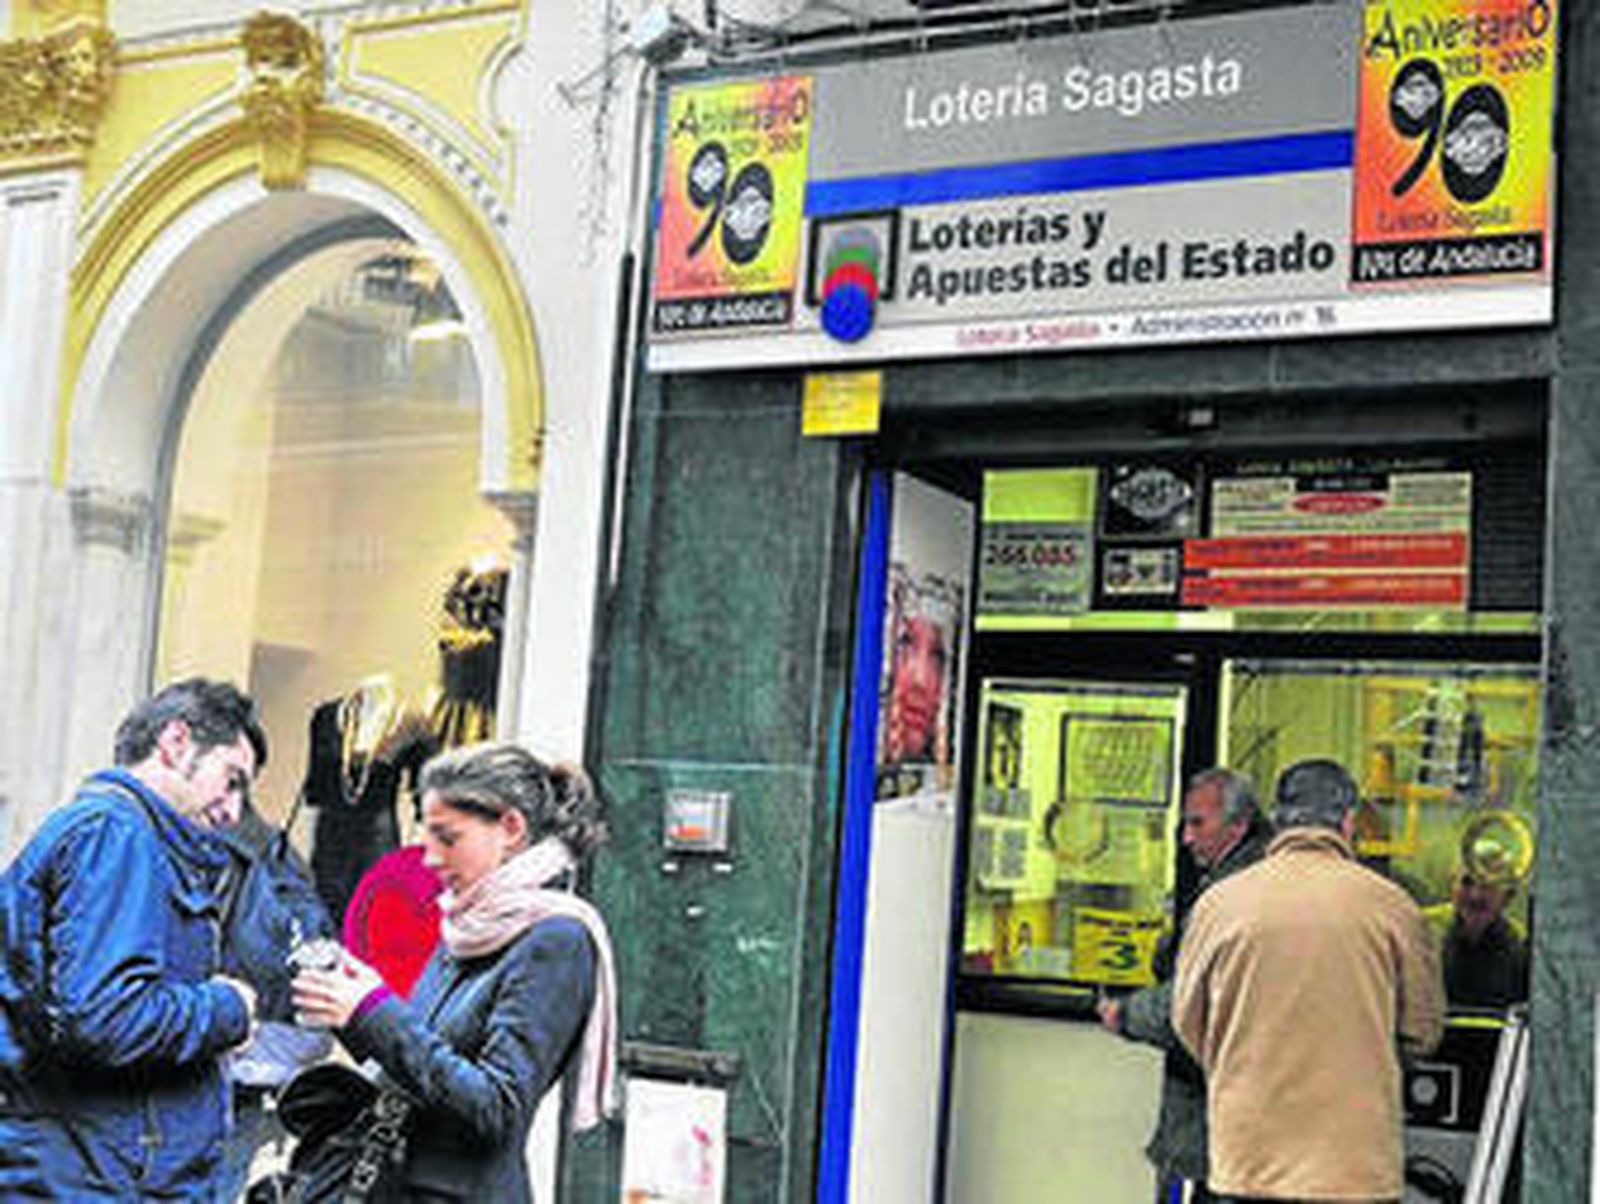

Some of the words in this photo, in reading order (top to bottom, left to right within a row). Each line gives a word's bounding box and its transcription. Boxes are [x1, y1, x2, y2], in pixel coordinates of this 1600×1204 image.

[904, 71, 1048, 129] Lotería
[1062, 55, 1241, 116] Sagasta
[1389, 58, 1509, 204] 90
[686, 140, 774, 265] 90
[908, 211, 1070, 253] Loterías
[1082, 210, 1107, 250] y
[907, 255, 1092, 304] Apuestas
[1105, 245, 1169, 284] del
[1183, 233, 1336, 280] Estado
